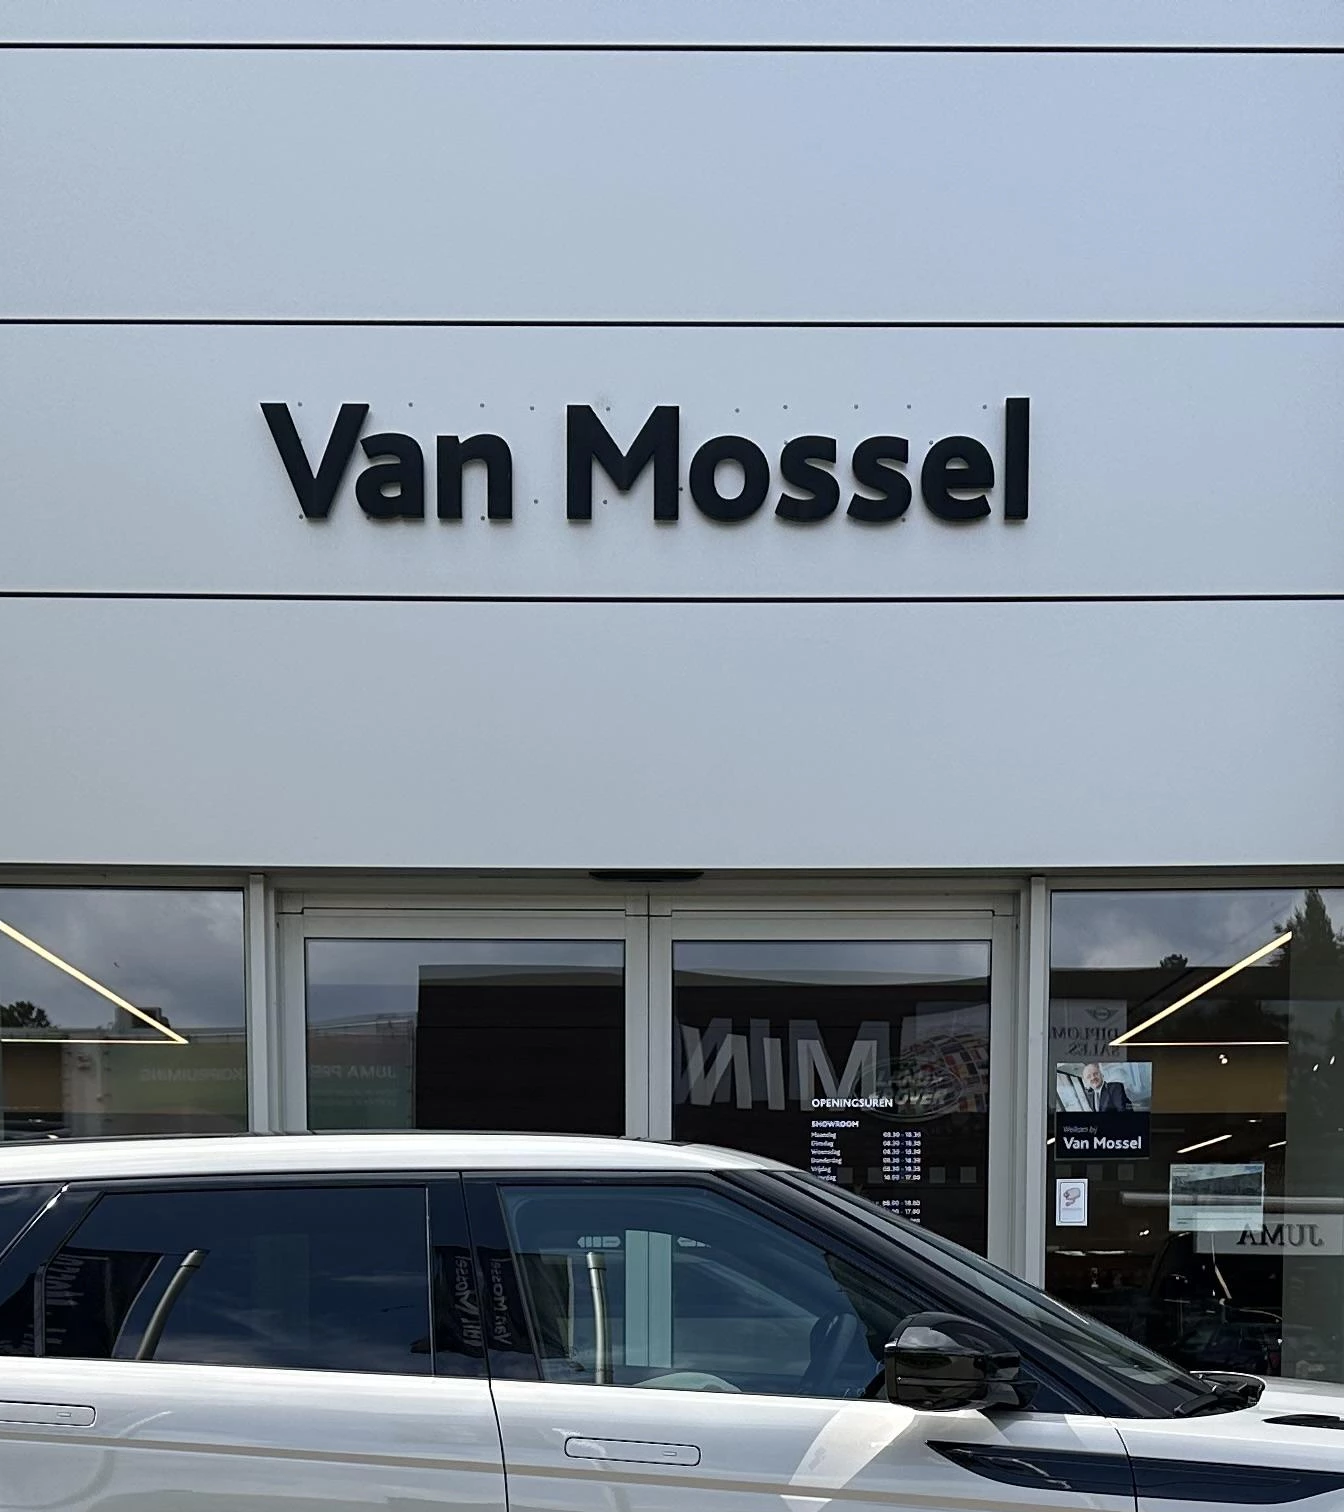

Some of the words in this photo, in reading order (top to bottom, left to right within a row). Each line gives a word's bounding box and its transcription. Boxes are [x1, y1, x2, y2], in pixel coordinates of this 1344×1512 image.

[259, 402, 513, 520] Van
[566, 397, 1030, 522] Mossel
[811, 1098, 893, 1108] OPENINGSUREN
[811, 1120, 860, 1128] SHOWROOM
[1063, 1137, 1090, 1149] Van
[1094, 1136, 1142, 1149] Mossel
